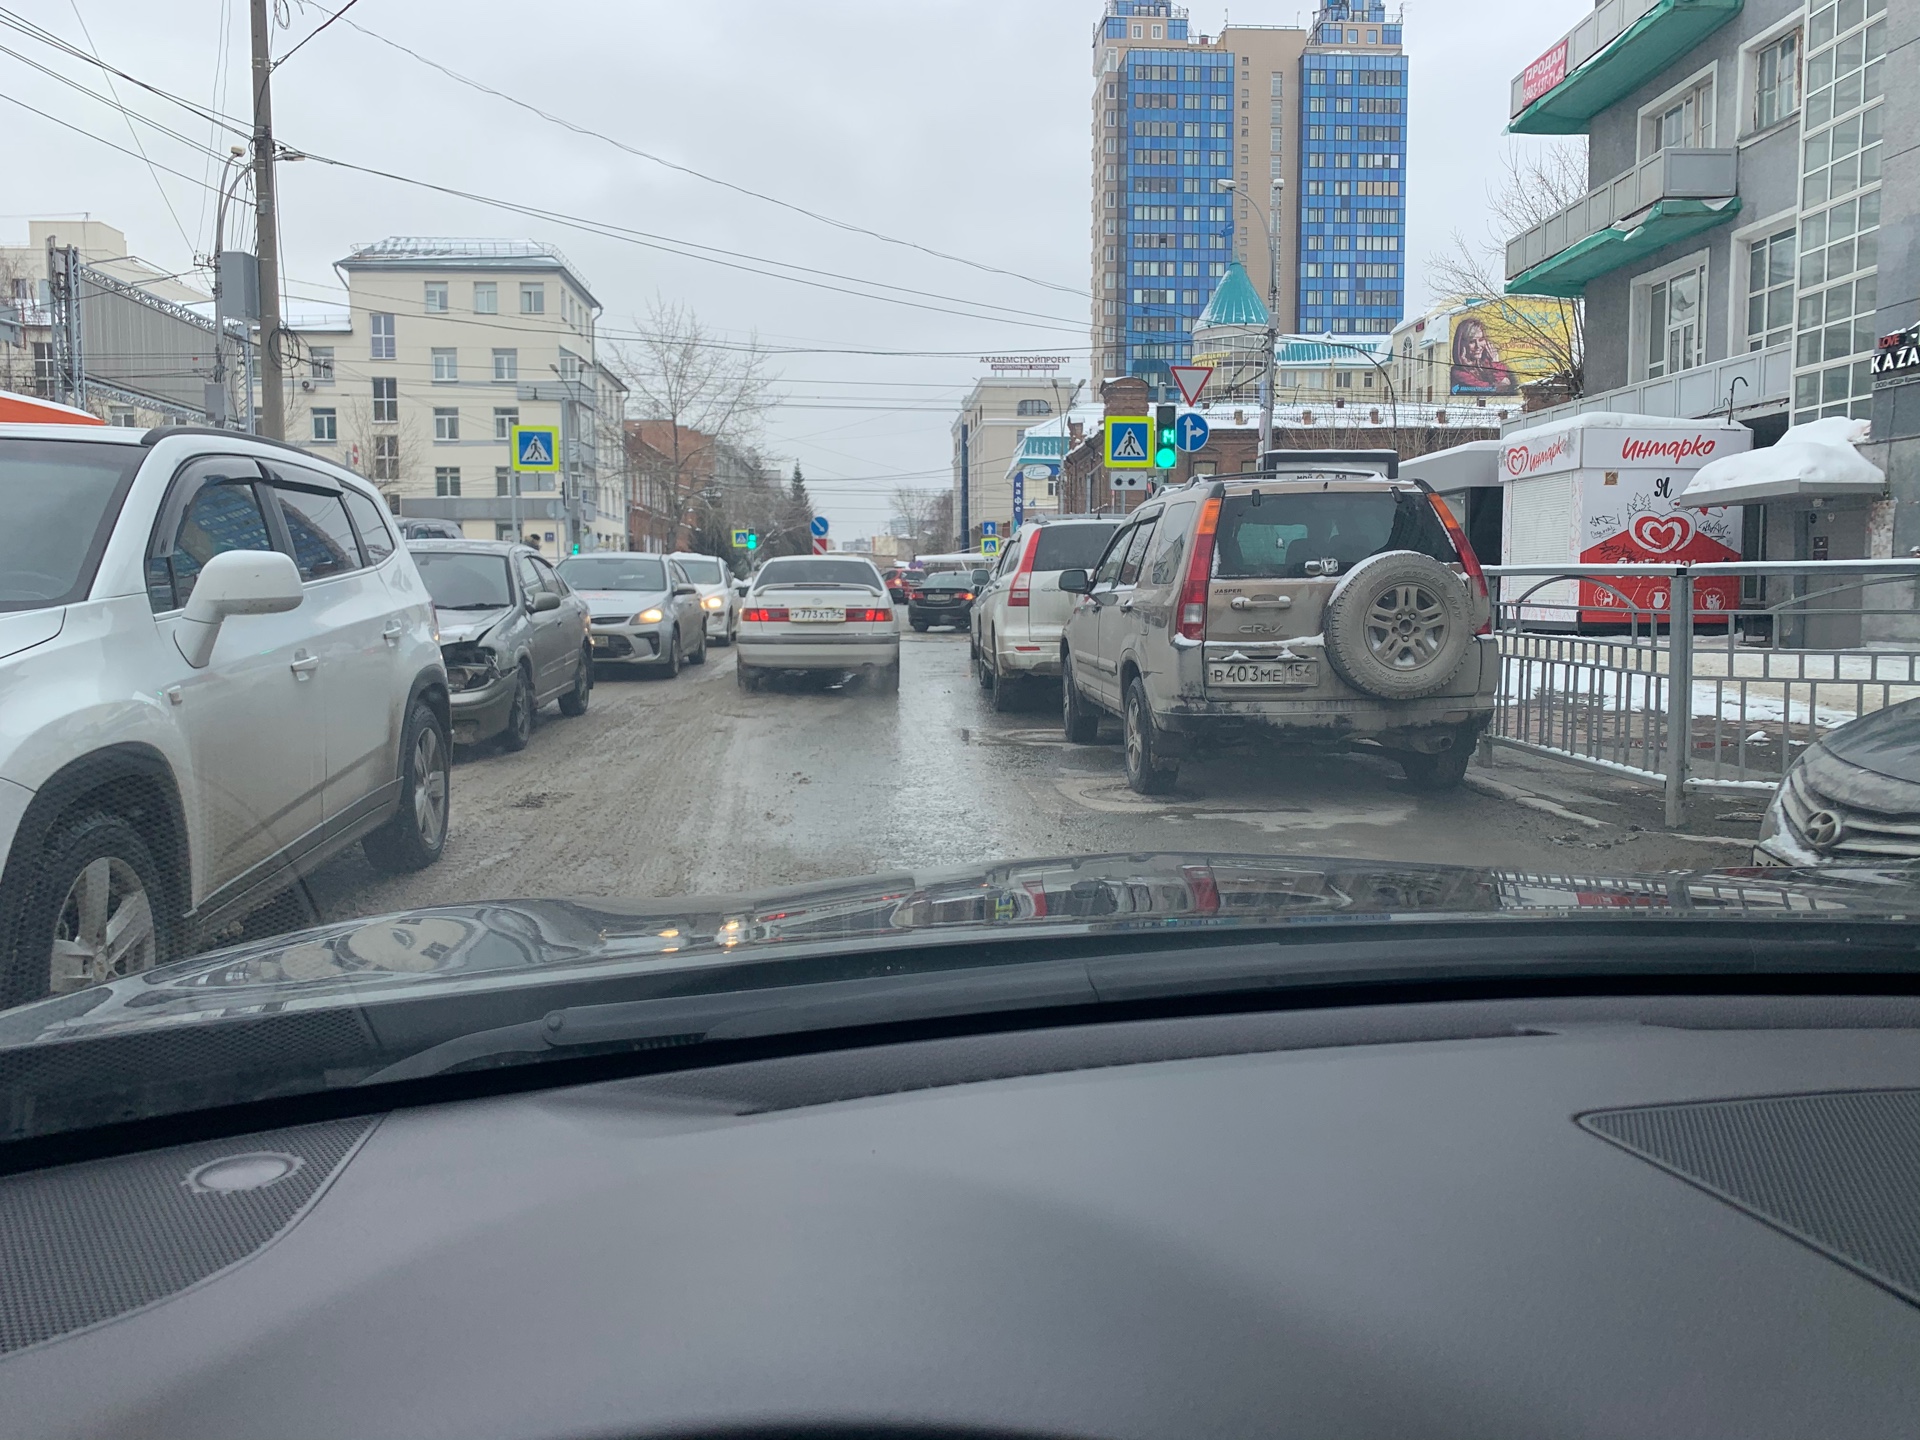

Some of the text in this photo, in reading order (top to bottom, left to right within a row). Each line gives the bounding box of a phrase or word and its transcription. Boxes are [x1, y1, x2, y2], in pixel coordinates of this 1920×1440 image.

[1525, 44, 1566, 83] ПРОДАМ
[1878, 334, 1900, 349] LOVE
[980, 355, 1070, 364] АКАДЕМСТРОЙПРОЕКТ
[1238, 624, 1283, 634] CR-V
